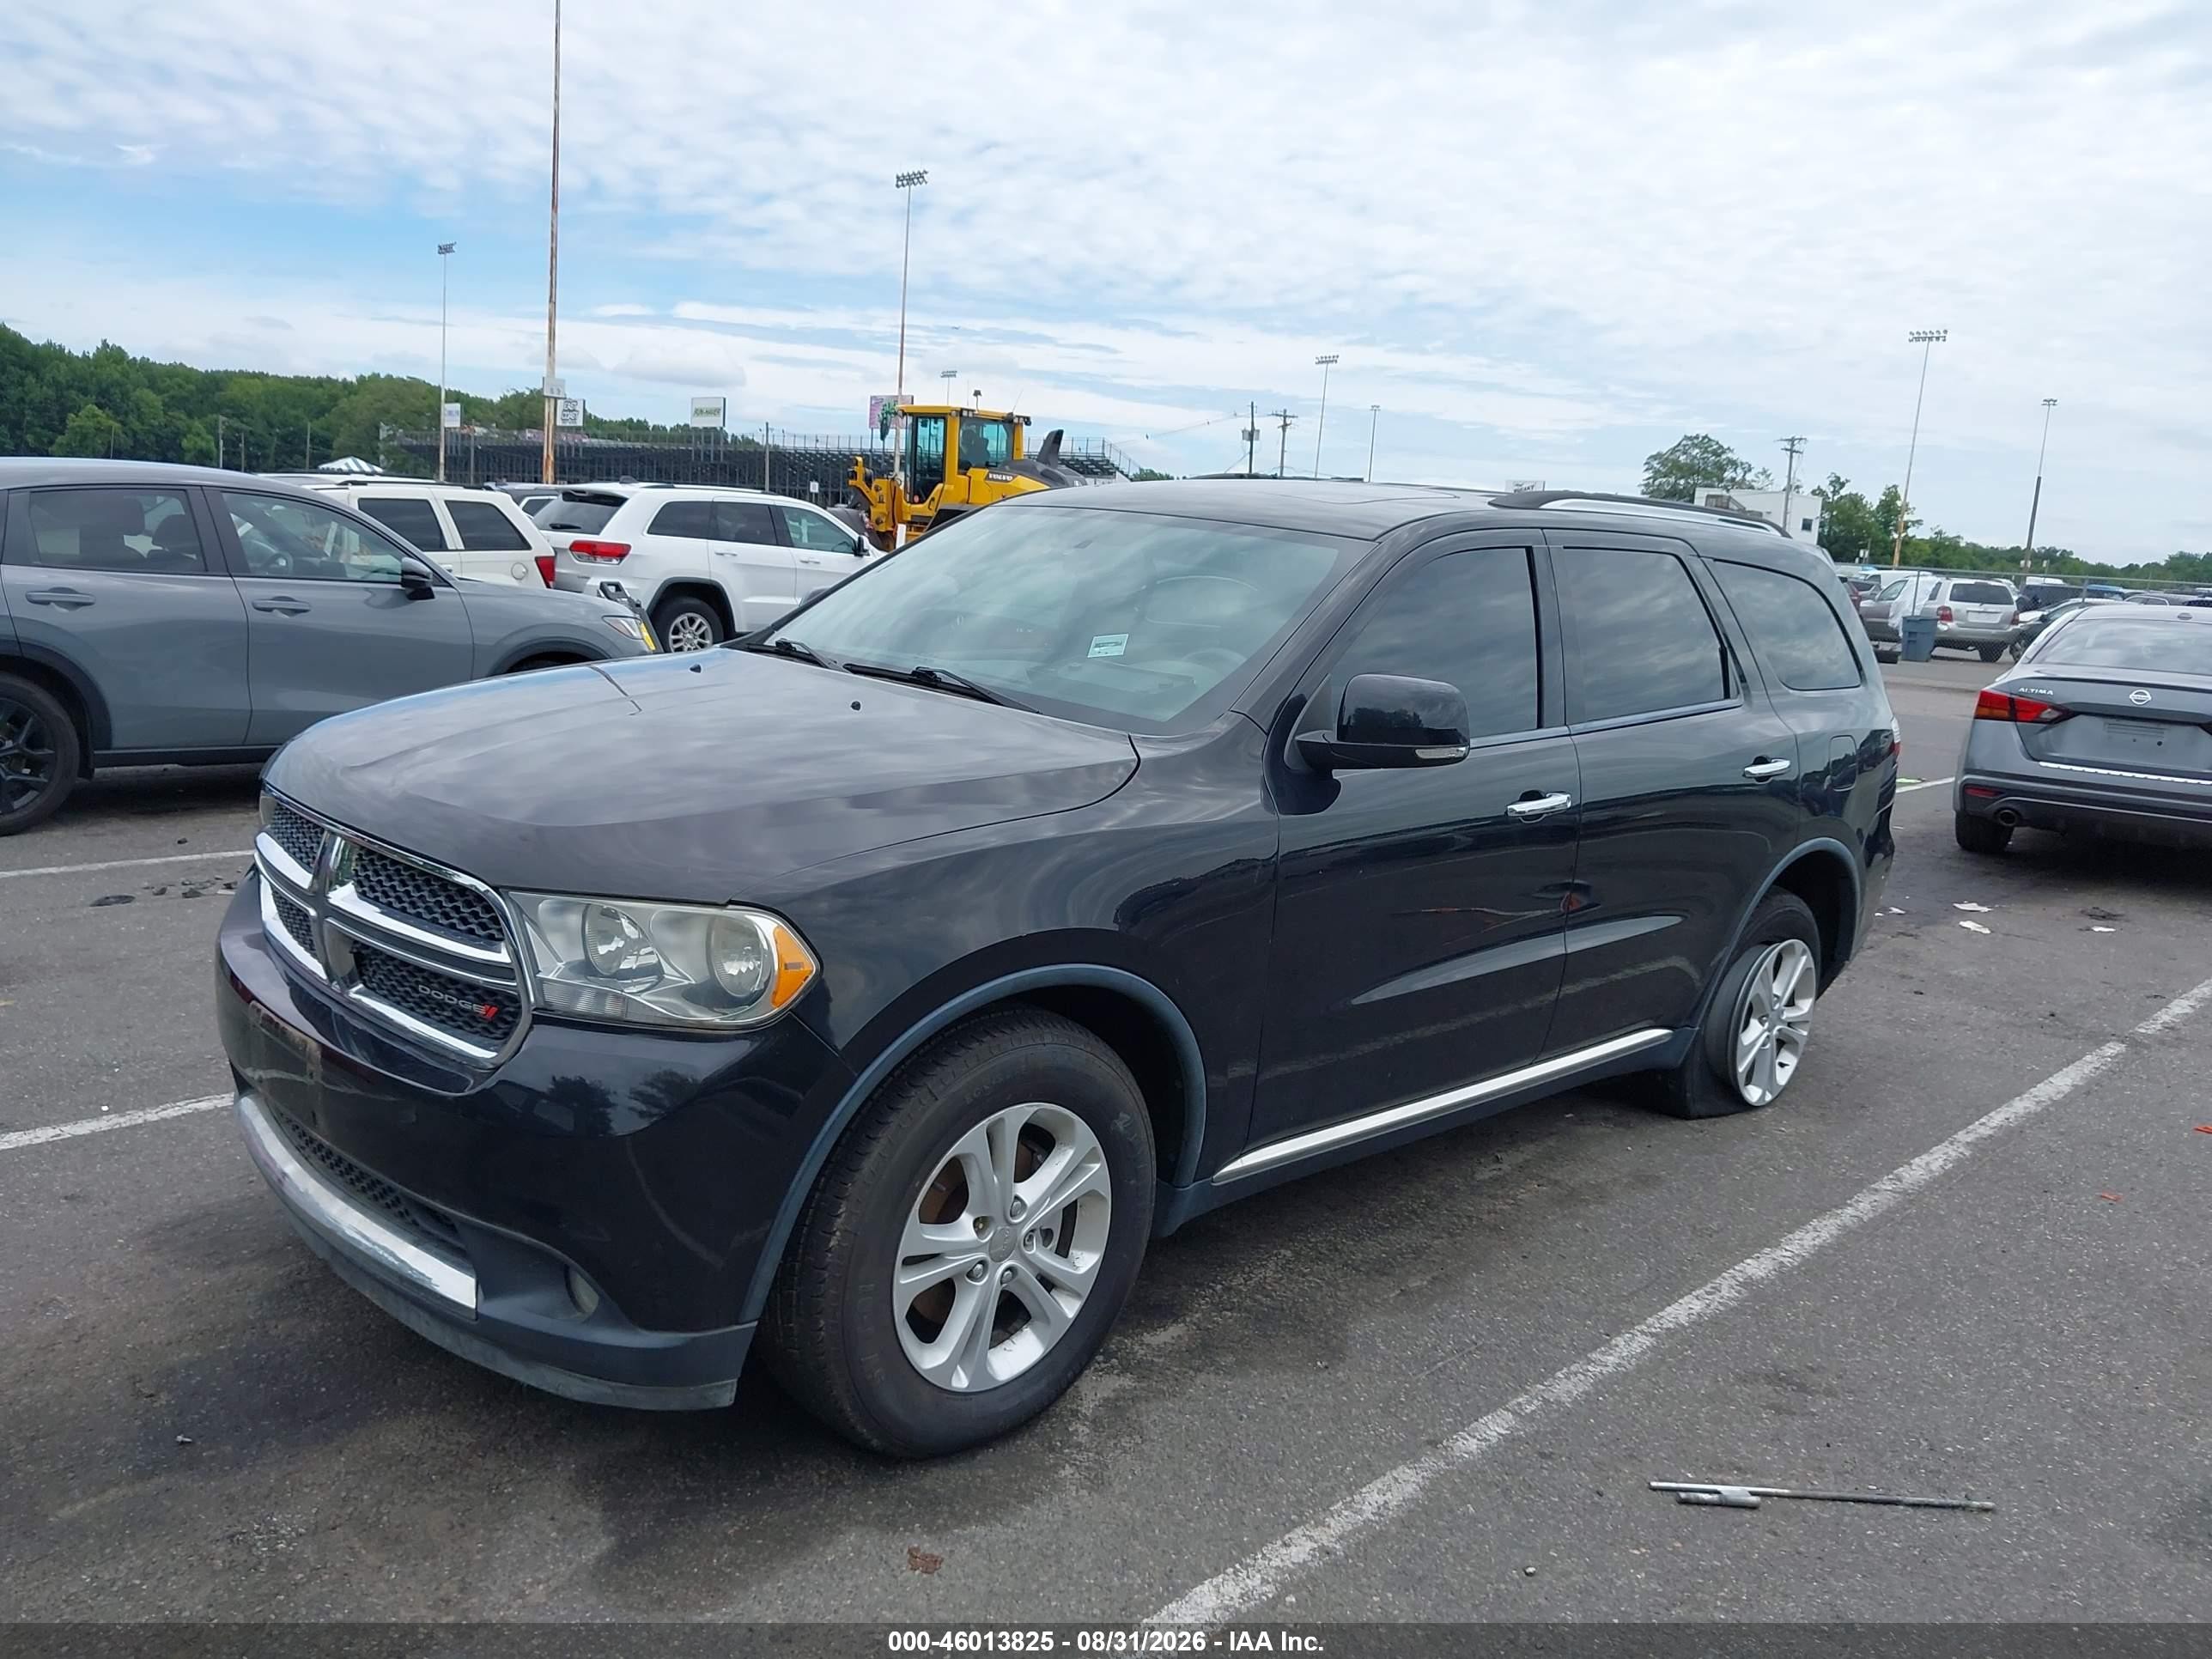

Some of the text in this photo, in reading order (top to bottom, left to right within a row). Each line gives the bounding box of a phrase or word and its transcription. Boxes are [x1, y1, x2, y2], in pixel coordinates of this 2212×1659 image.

[988, 473, 1013, 482] VOLVO
[2018, 687, 2054, 696] ALTIMA
[418, 985, 487, 1015] DODGE
